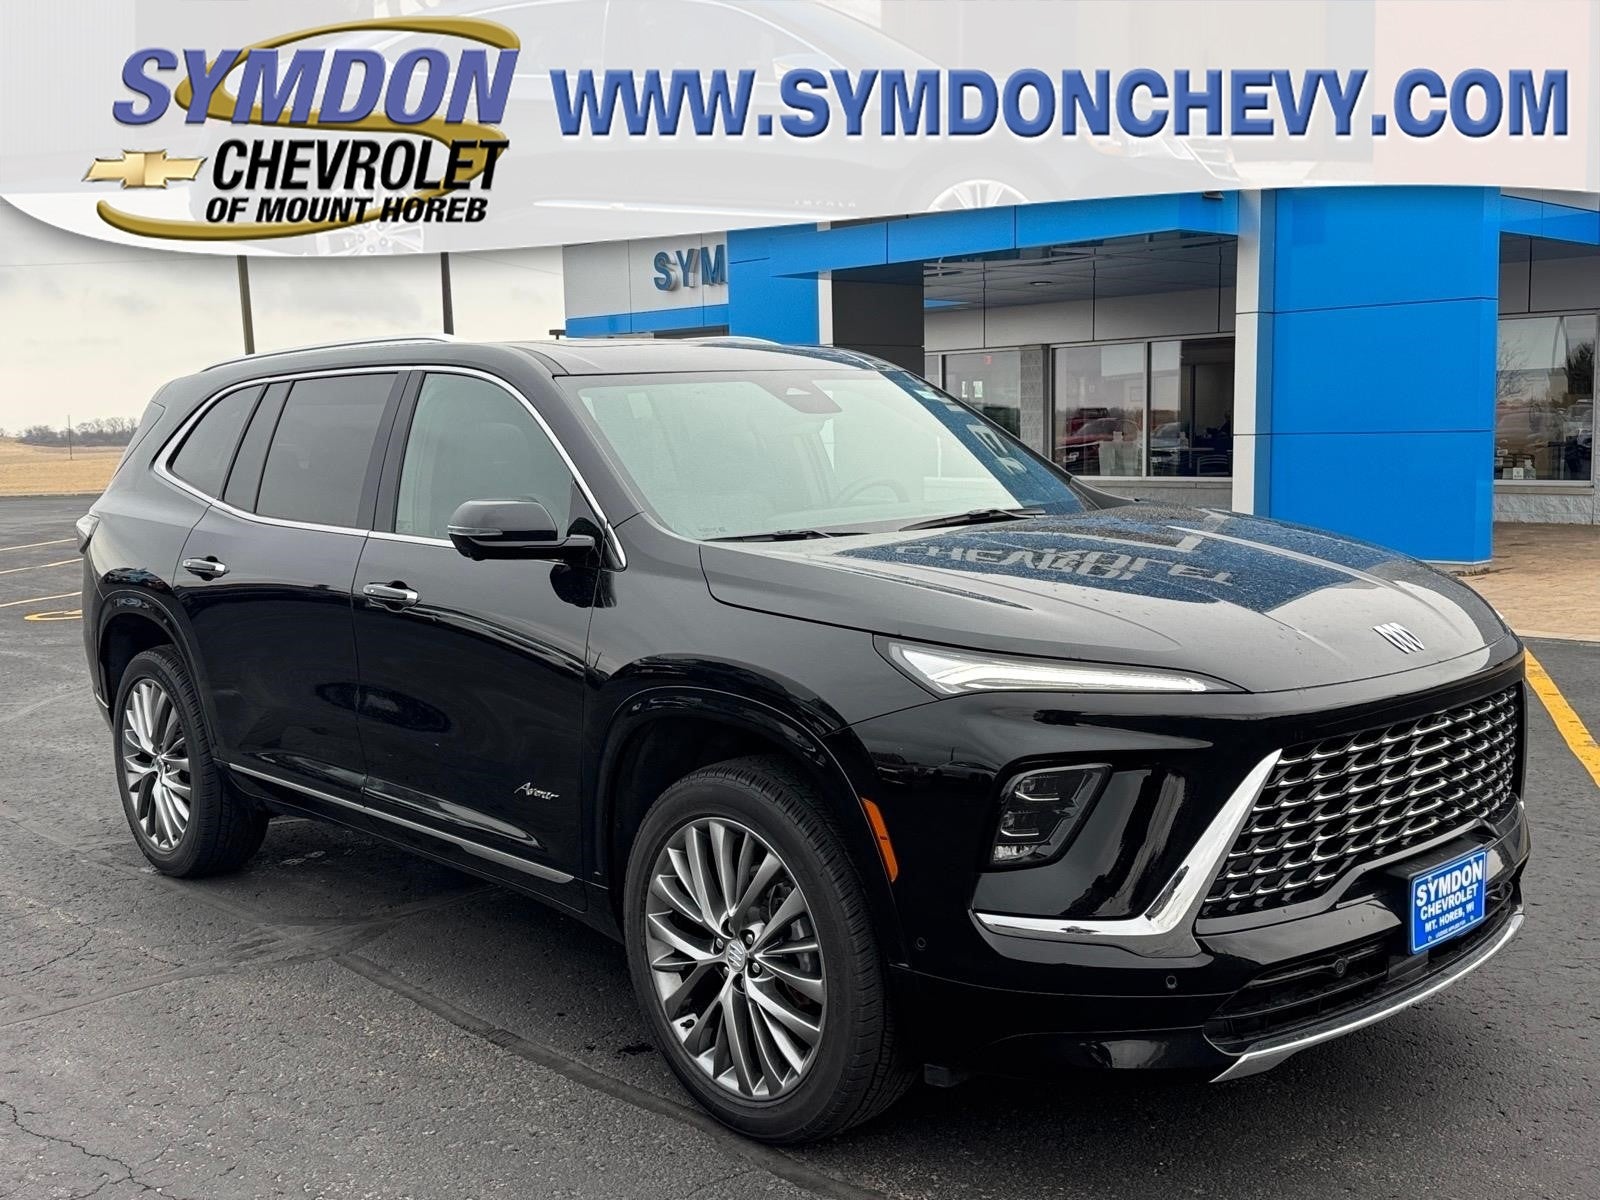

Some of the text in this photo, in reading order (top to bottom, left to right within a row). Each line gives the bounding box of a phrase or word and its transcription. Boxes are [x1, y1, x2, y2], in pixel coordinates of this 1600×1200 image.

[1416, 860, 1483, 907] SYMDON
[1420, 883, 1479, 920] CHEVROLET
[1424, 919, 1438, 933] MT.
[1465, 902, 1475, 914] WI
